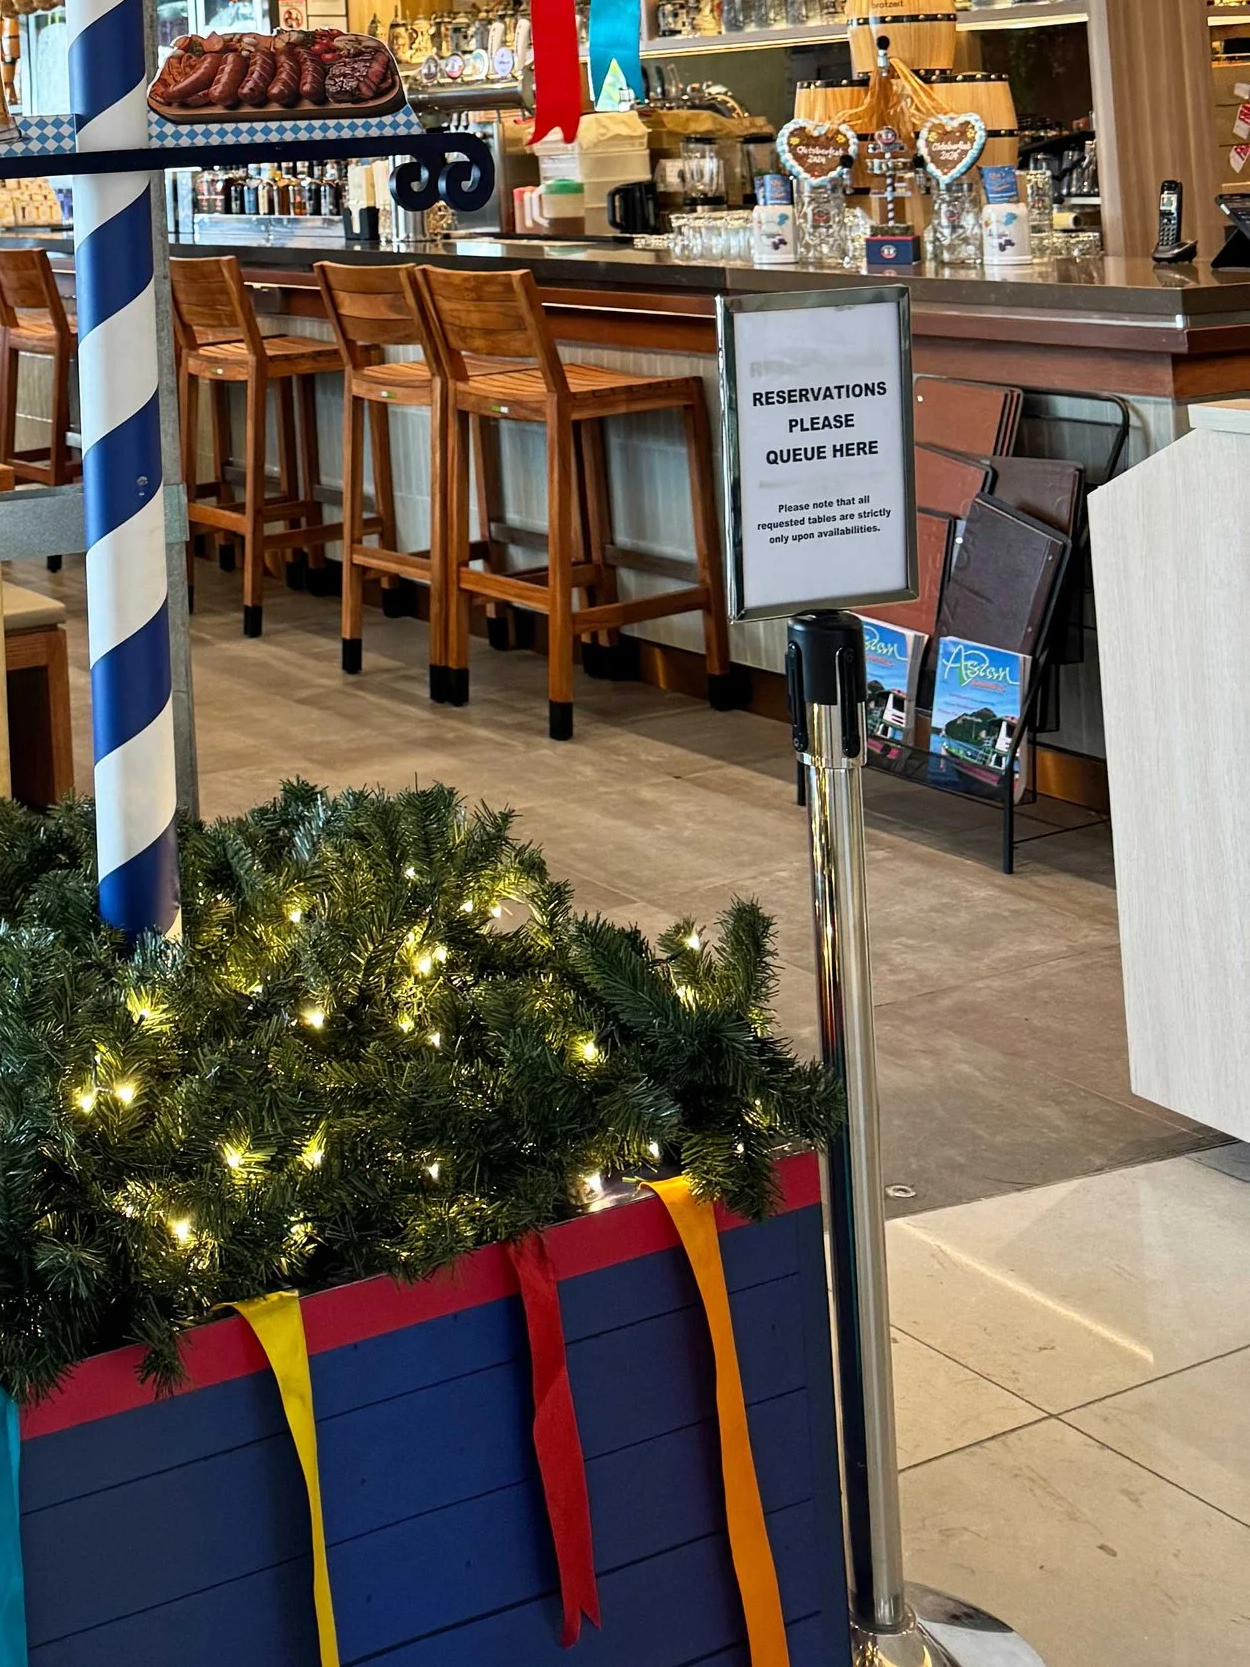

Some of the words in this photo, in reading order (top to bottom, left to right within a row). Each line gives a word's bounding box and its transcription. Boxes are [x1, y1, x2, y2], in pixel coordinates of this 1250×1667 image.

[752, 382, 887, 407] RESERVATIONS
[788, 413, 855, 433] PLEASE
[766, 445, 827, 465] QUEUE
[832, 440, 879, 459] HERE
[778, 503, 810, 513] Please
[813, 500, 834, 509] note
[836, 497, 856, 507] that
[858, 495, 870, 504] all
[757, 517, 805, 531] requested
[808, 513, 837, 525] tables
[839, 512, 855, 521] are
[857, 508, 891, 521] strictly
[769, 534, 789, 545] only
[792, 532, 815, 543] upon
[817, 524, 881, 539] availabilities.
